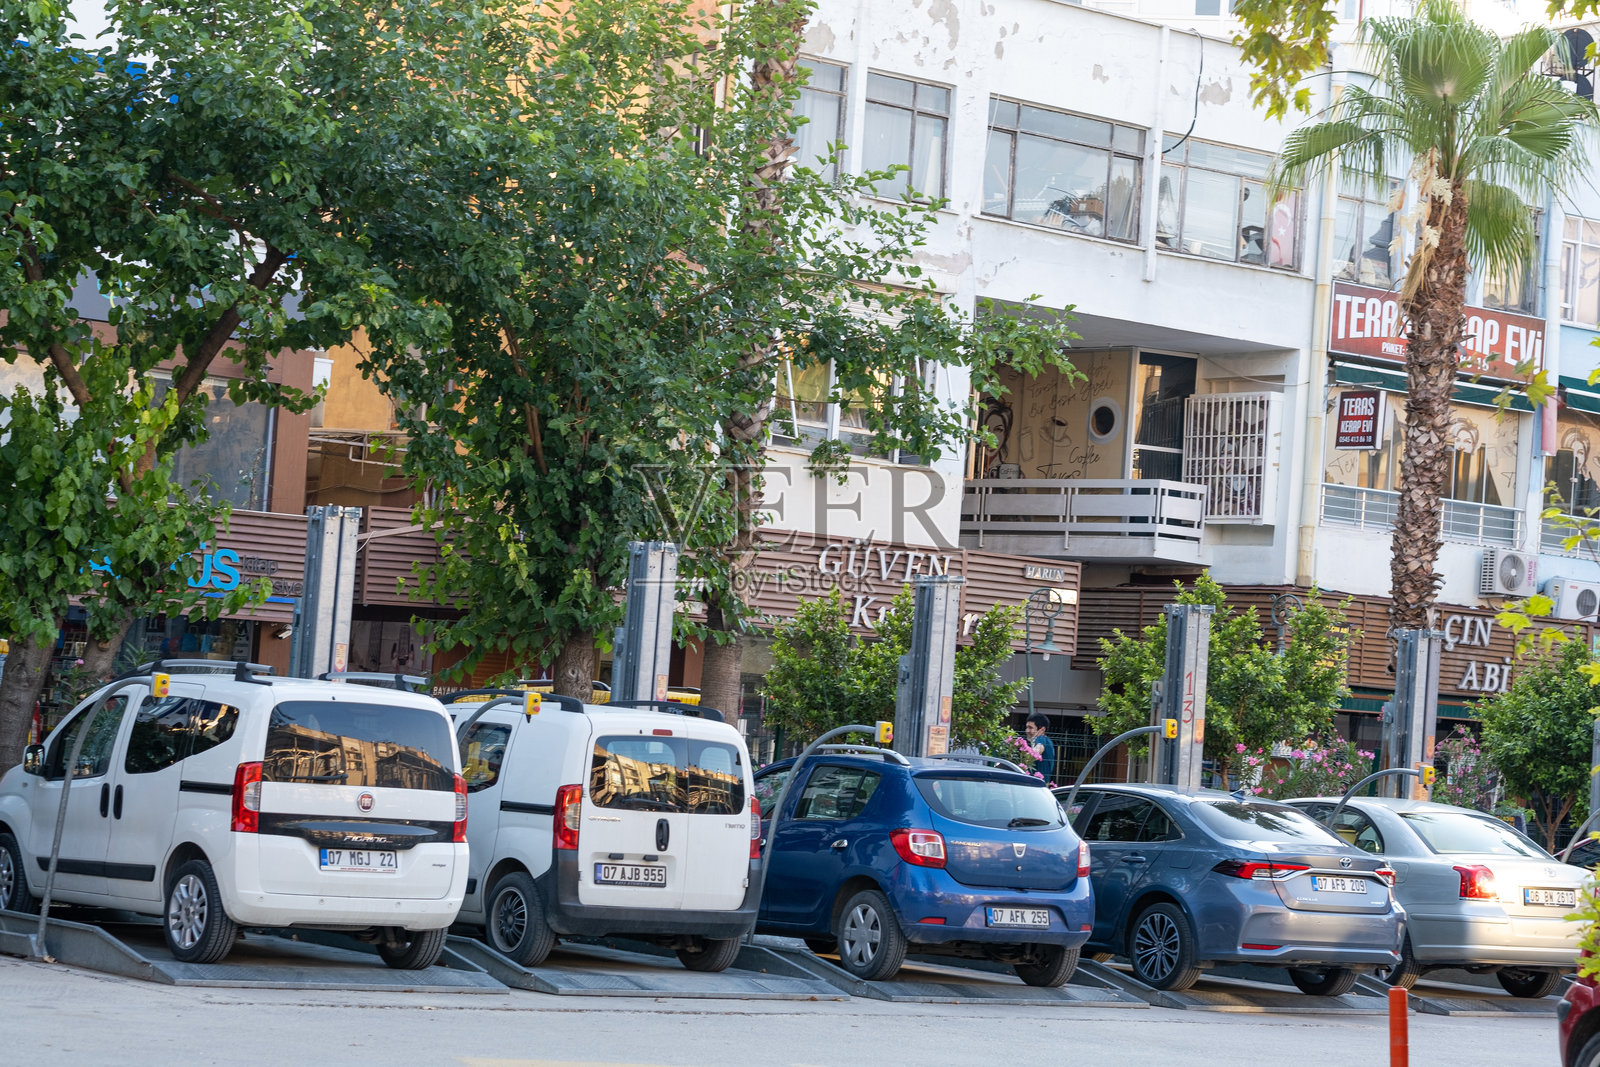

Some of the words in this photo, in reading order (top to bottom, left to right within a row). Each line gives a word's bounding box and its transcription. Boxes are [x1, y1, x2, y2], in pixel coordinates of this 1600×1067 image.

[1343, 397, 1375, 416] TERAS
[1340, 420, 1361, 433] KEBAP
[242, 555, 279, 575] kitap
[819, 538, 952, 583] GÜVEN
[1027, 566, 1064, 580] HARUN
[1458, 656, 1513, 693] ABİ
[328, 850, 342, 866] 07
[349, 851, 371, 866] MGJ
[379, 852, 394, 867] 22
[603, 866, 617, 880] 07
[620, 867, 641, 881] AJB
[643, 868, 664, 882] 955
[1317, 878, 1328, 890] 07
[1350, 880, 1365, 892] 209
[993, 909, 1004, 922] 07
[1009, 910, 1027, 923] AFK
[1031, 911, 1048, 924] 255
